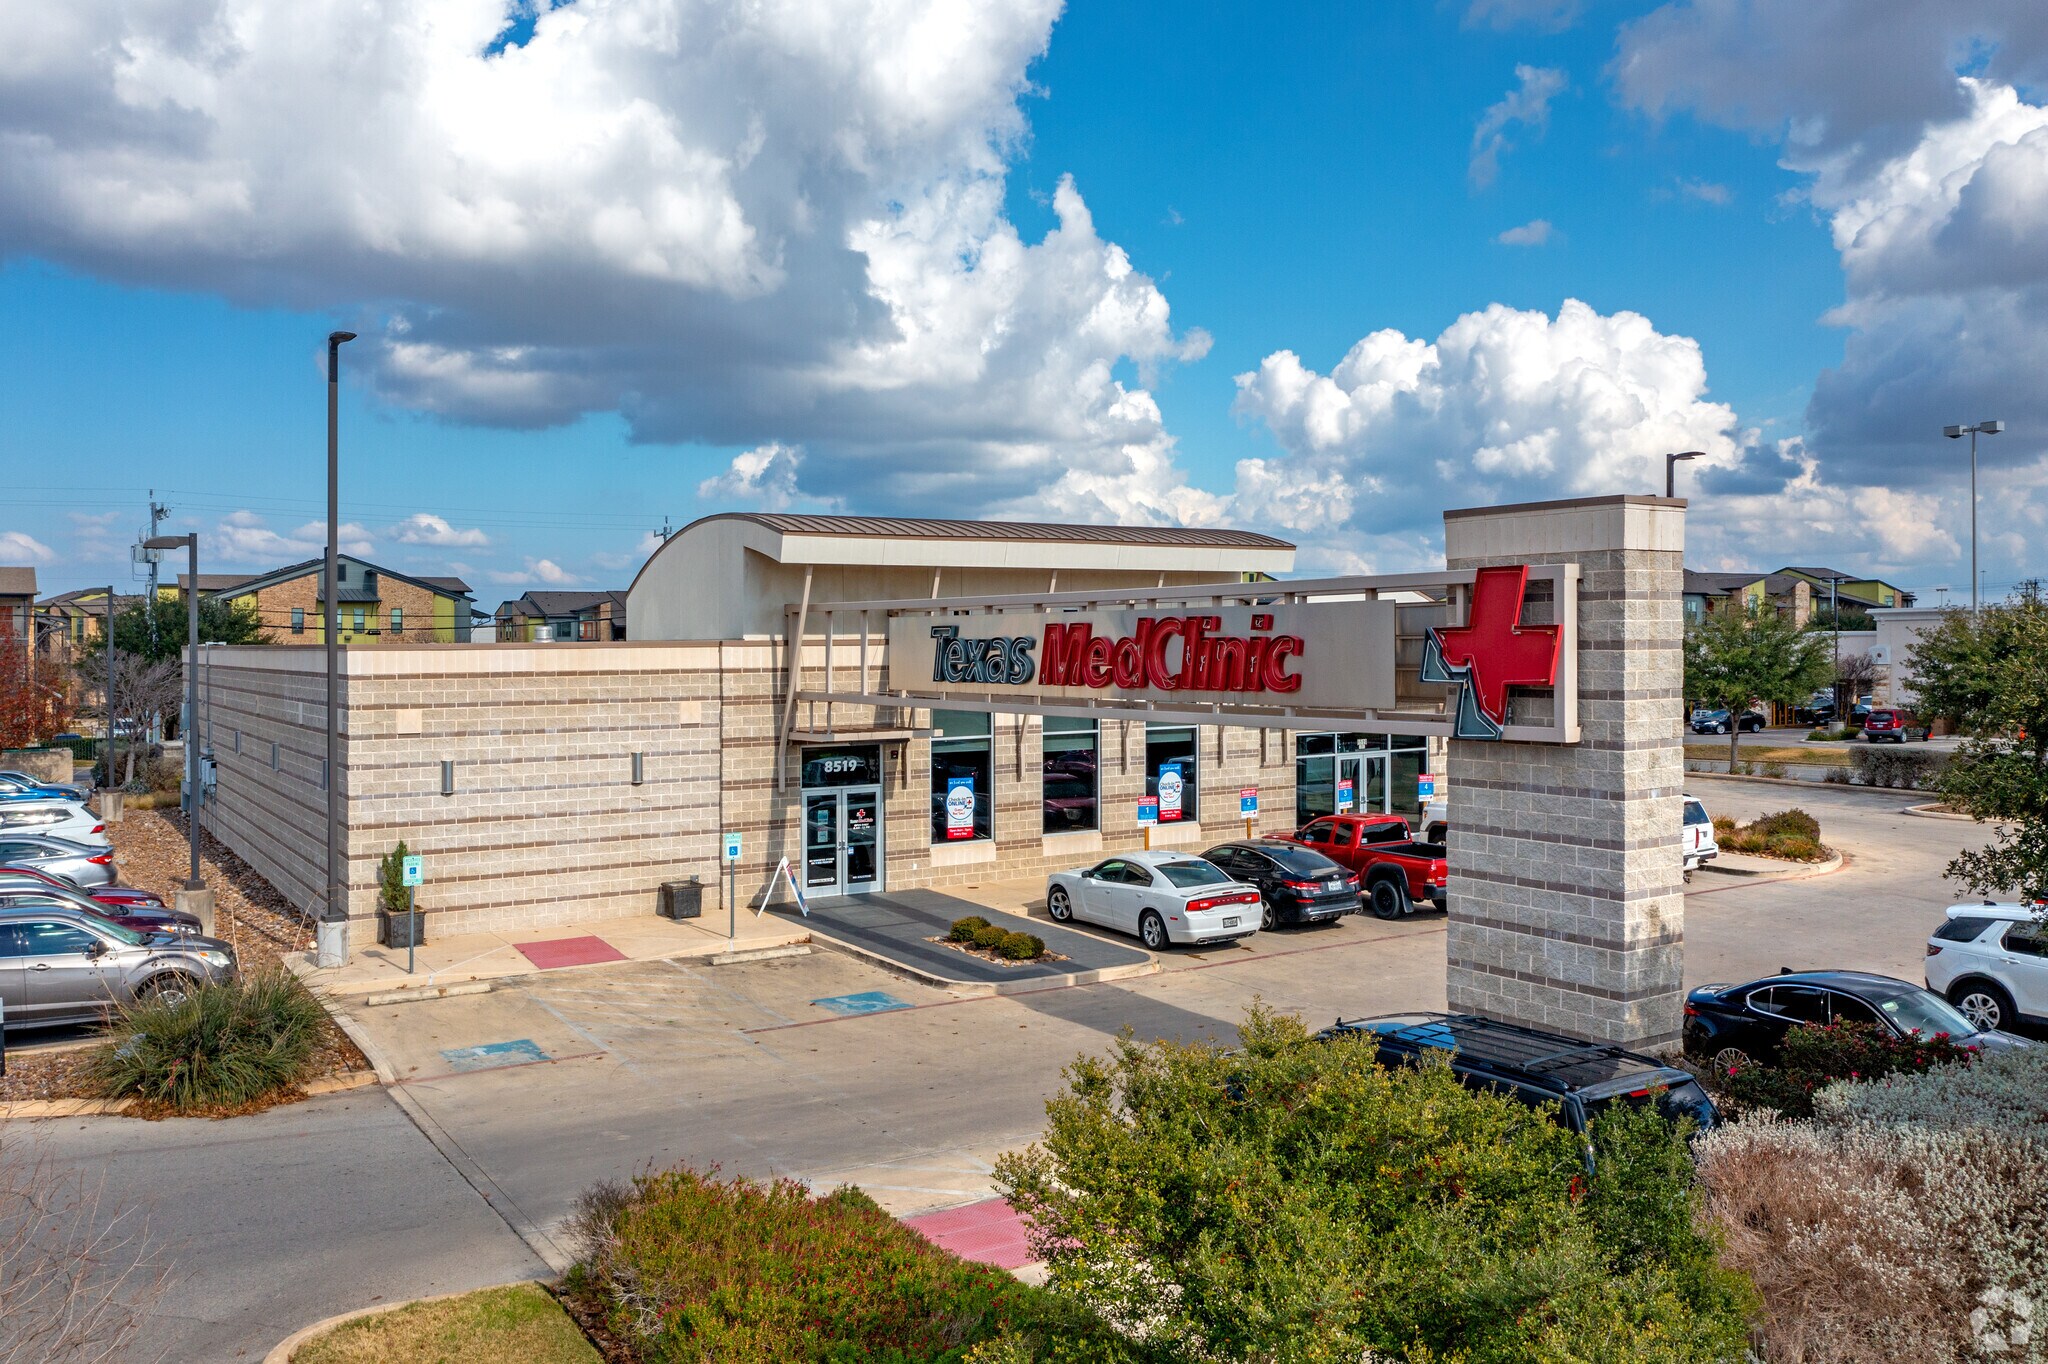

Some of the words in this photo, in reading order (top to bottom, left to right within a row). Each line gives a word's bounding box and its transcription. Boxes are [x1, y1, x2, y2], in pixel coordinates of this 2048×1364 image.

[931, 625, 1037, 685] Texas
[1038, 614, 1304, 693] MedClinic
[824, 760, 857, 772] 8519
[1246, 798, 1251, 806] 2
[1145, 806, 1150, 814] 1
